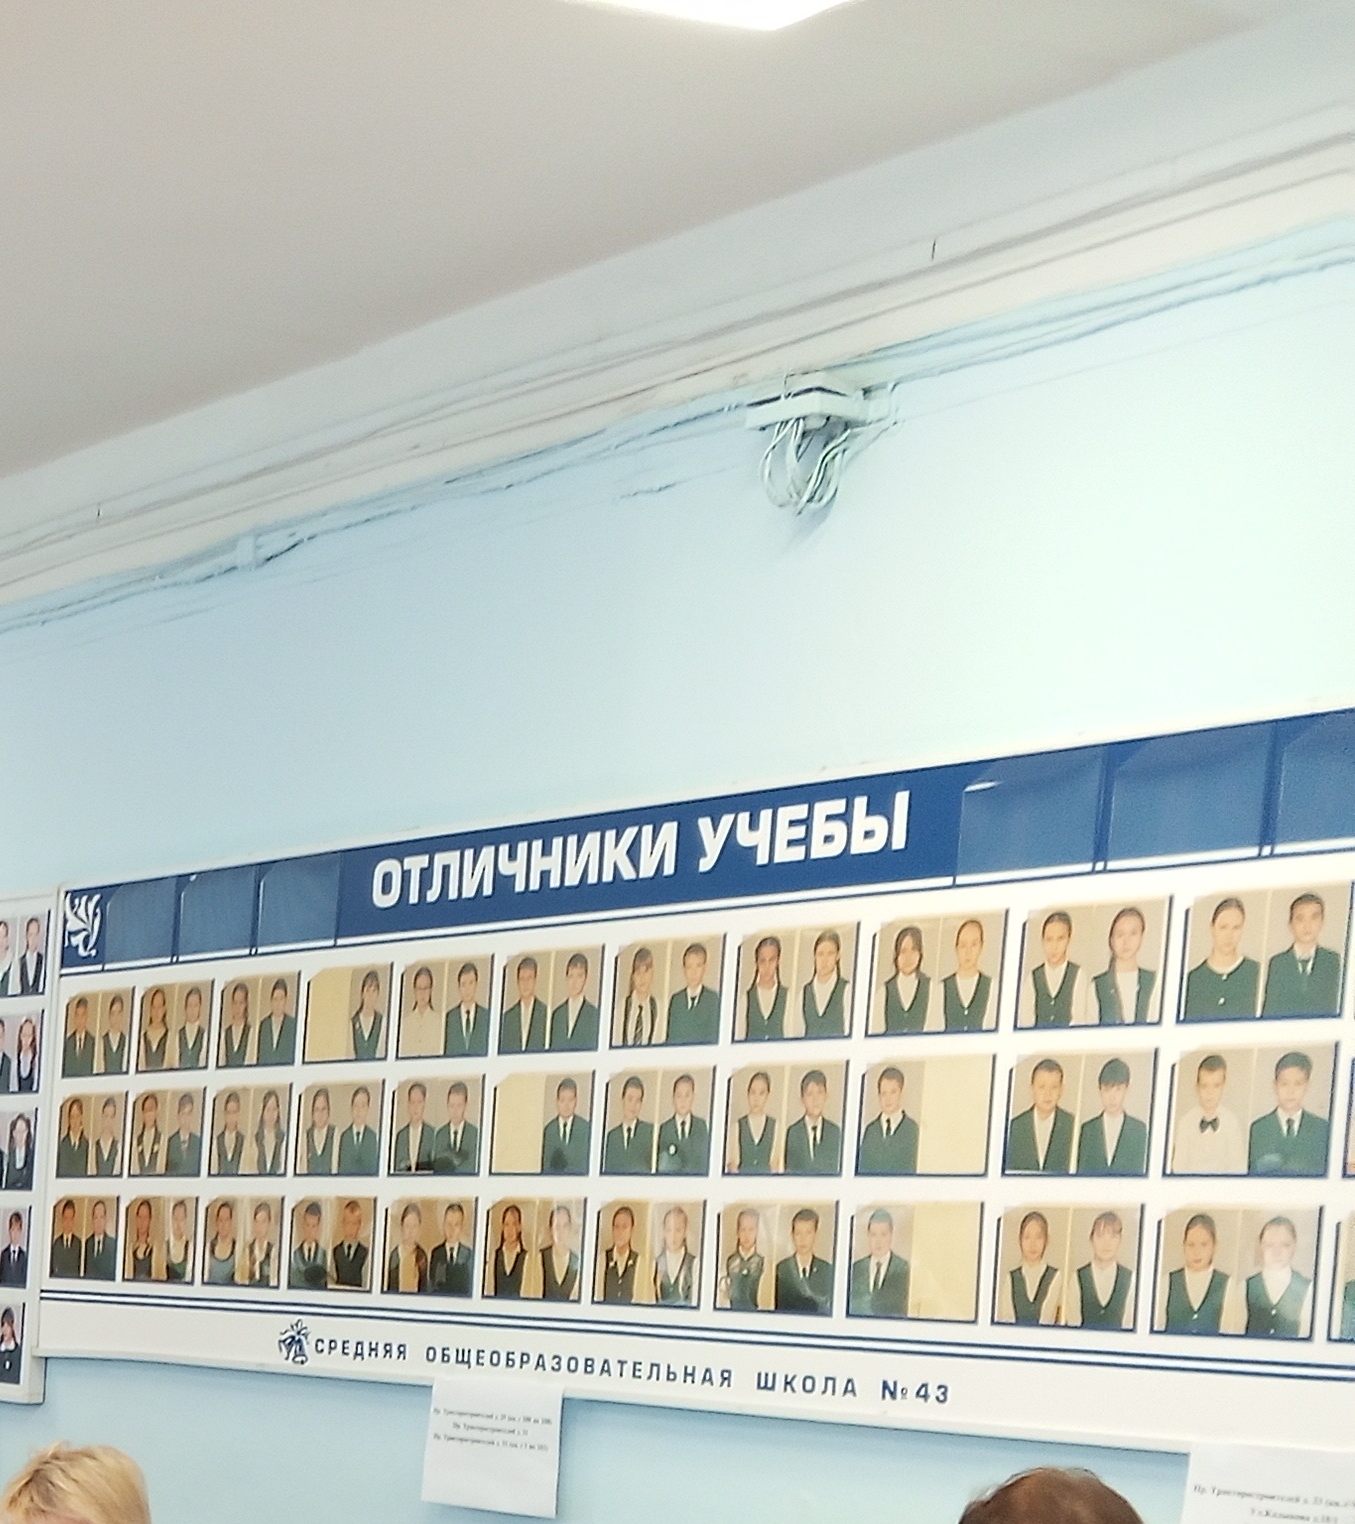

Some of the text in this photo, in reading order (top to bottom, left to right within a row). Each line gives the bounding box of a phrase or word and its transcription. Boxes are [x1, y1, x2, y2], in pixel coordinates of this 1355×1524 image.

[371, 790, 912, 909] ОТЛИЧНИКИ УЧЕБЫ
[313, 1336, 409, 1362] СРЕДНЯЯ
[425, 1345, 733, 1389] ОБЩЕОБРАЗОВАТЕЛЬНАЯ
[756, 1372, 859, 1399] ШКОЛА
